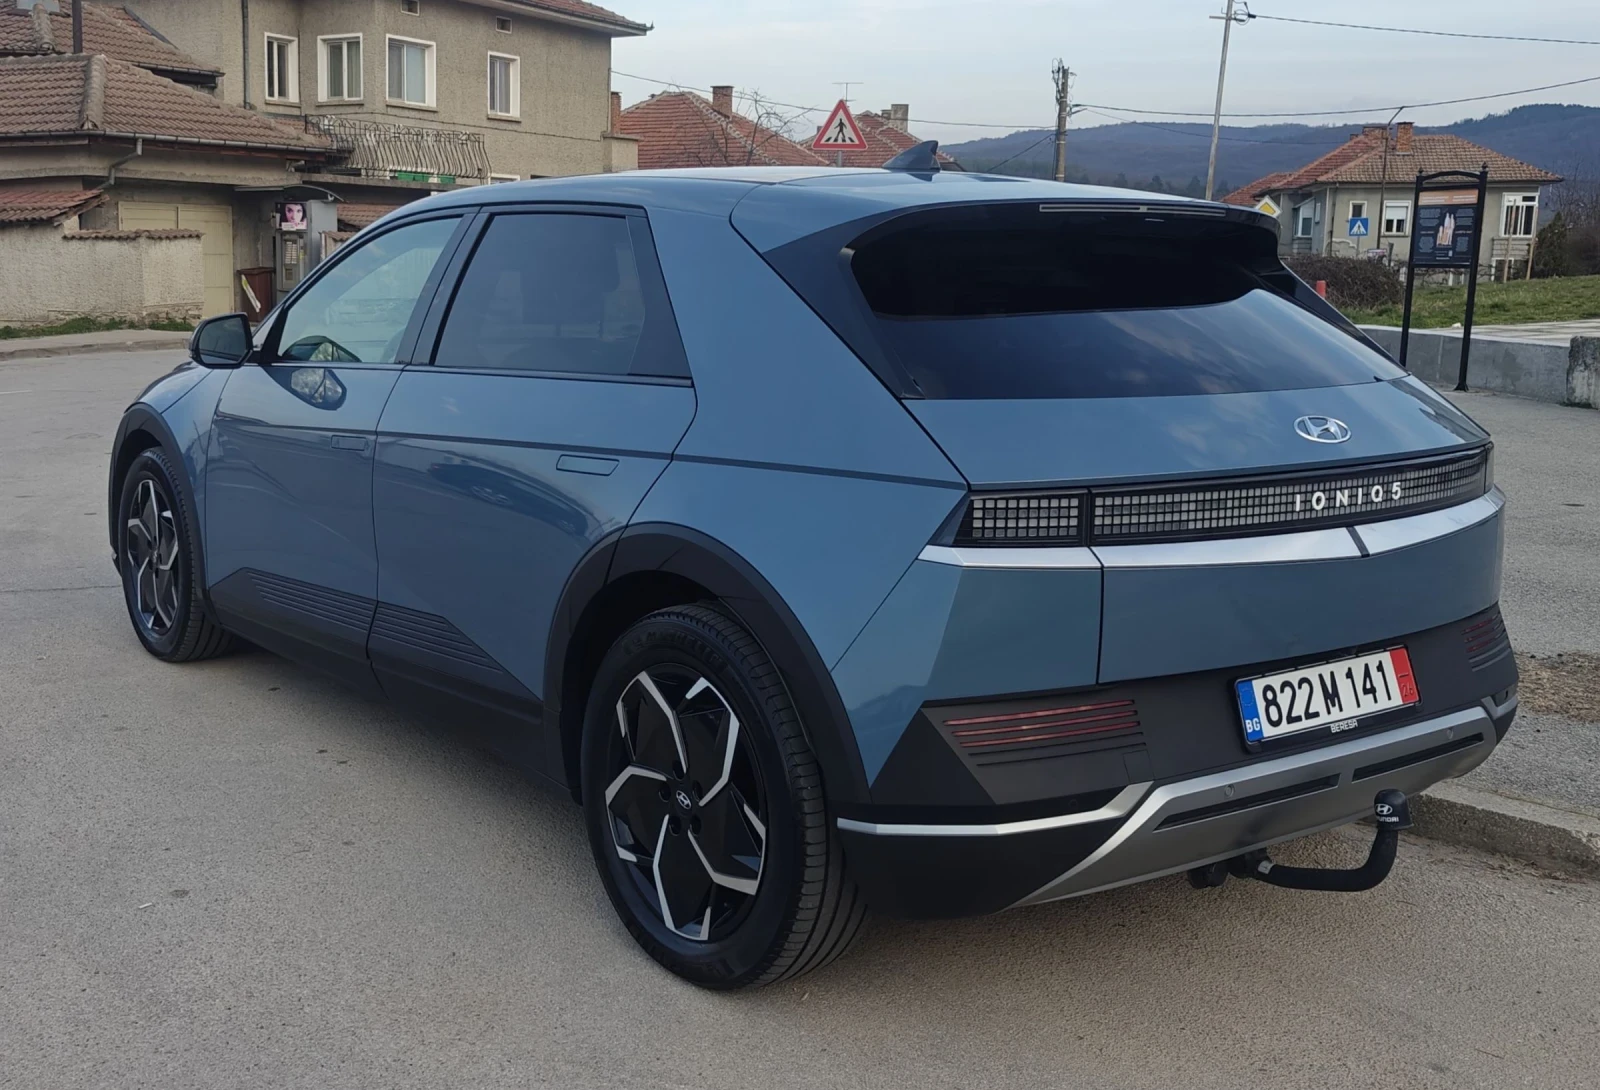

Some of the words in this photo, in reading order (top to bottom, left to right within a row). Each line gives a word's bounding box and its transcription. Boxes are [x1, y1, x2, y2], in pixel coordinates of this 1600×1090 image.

[1295, 485, 1383, 512] IONIQ
[1391, 481, 1402, 500] 5
[1245, 718, 1261, 733] BG
[1329, 719, 1358, 734] BERESA
